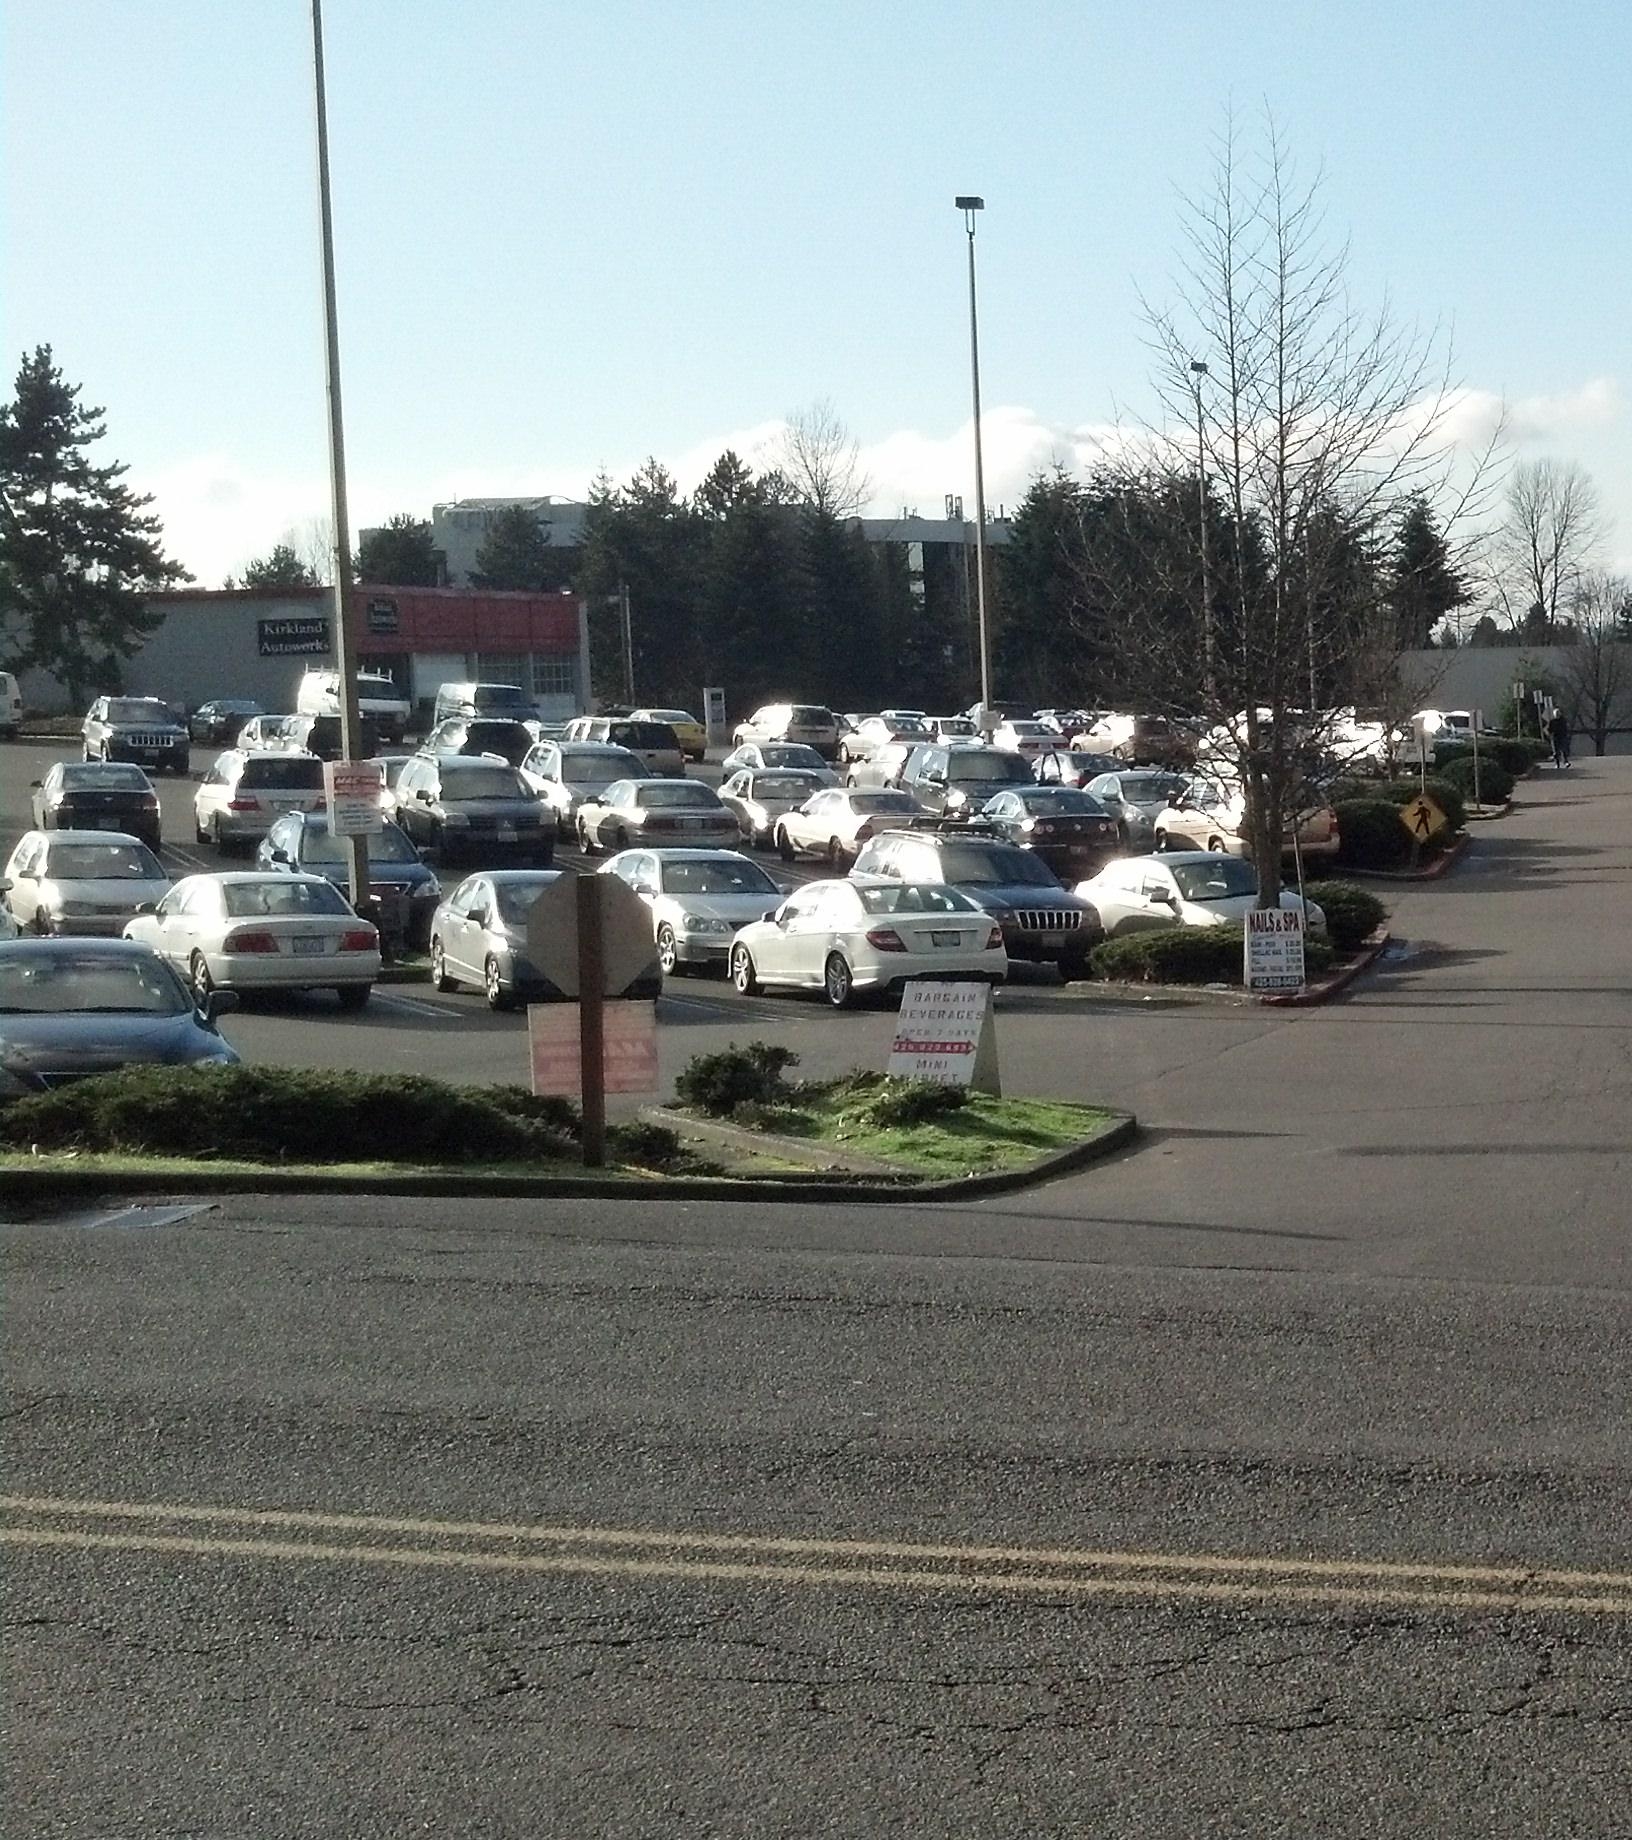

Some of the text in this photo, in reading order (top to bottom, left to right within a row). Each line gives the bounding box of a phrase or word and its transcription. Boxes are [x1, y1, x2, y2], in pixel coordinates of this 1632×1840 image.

[263, 621, 324, 636] Kirkland
[260, 640, 330, 653] Autoworks
[1249, 911, 1275, 933] NAILS
[1282, 911, 1300, 932] SPA
[914, 992, 977, 1003] BARGAIN
[900, 1009, 984, 1020] BEVERAGES
[916, 1060, 948, 1069] MINI
